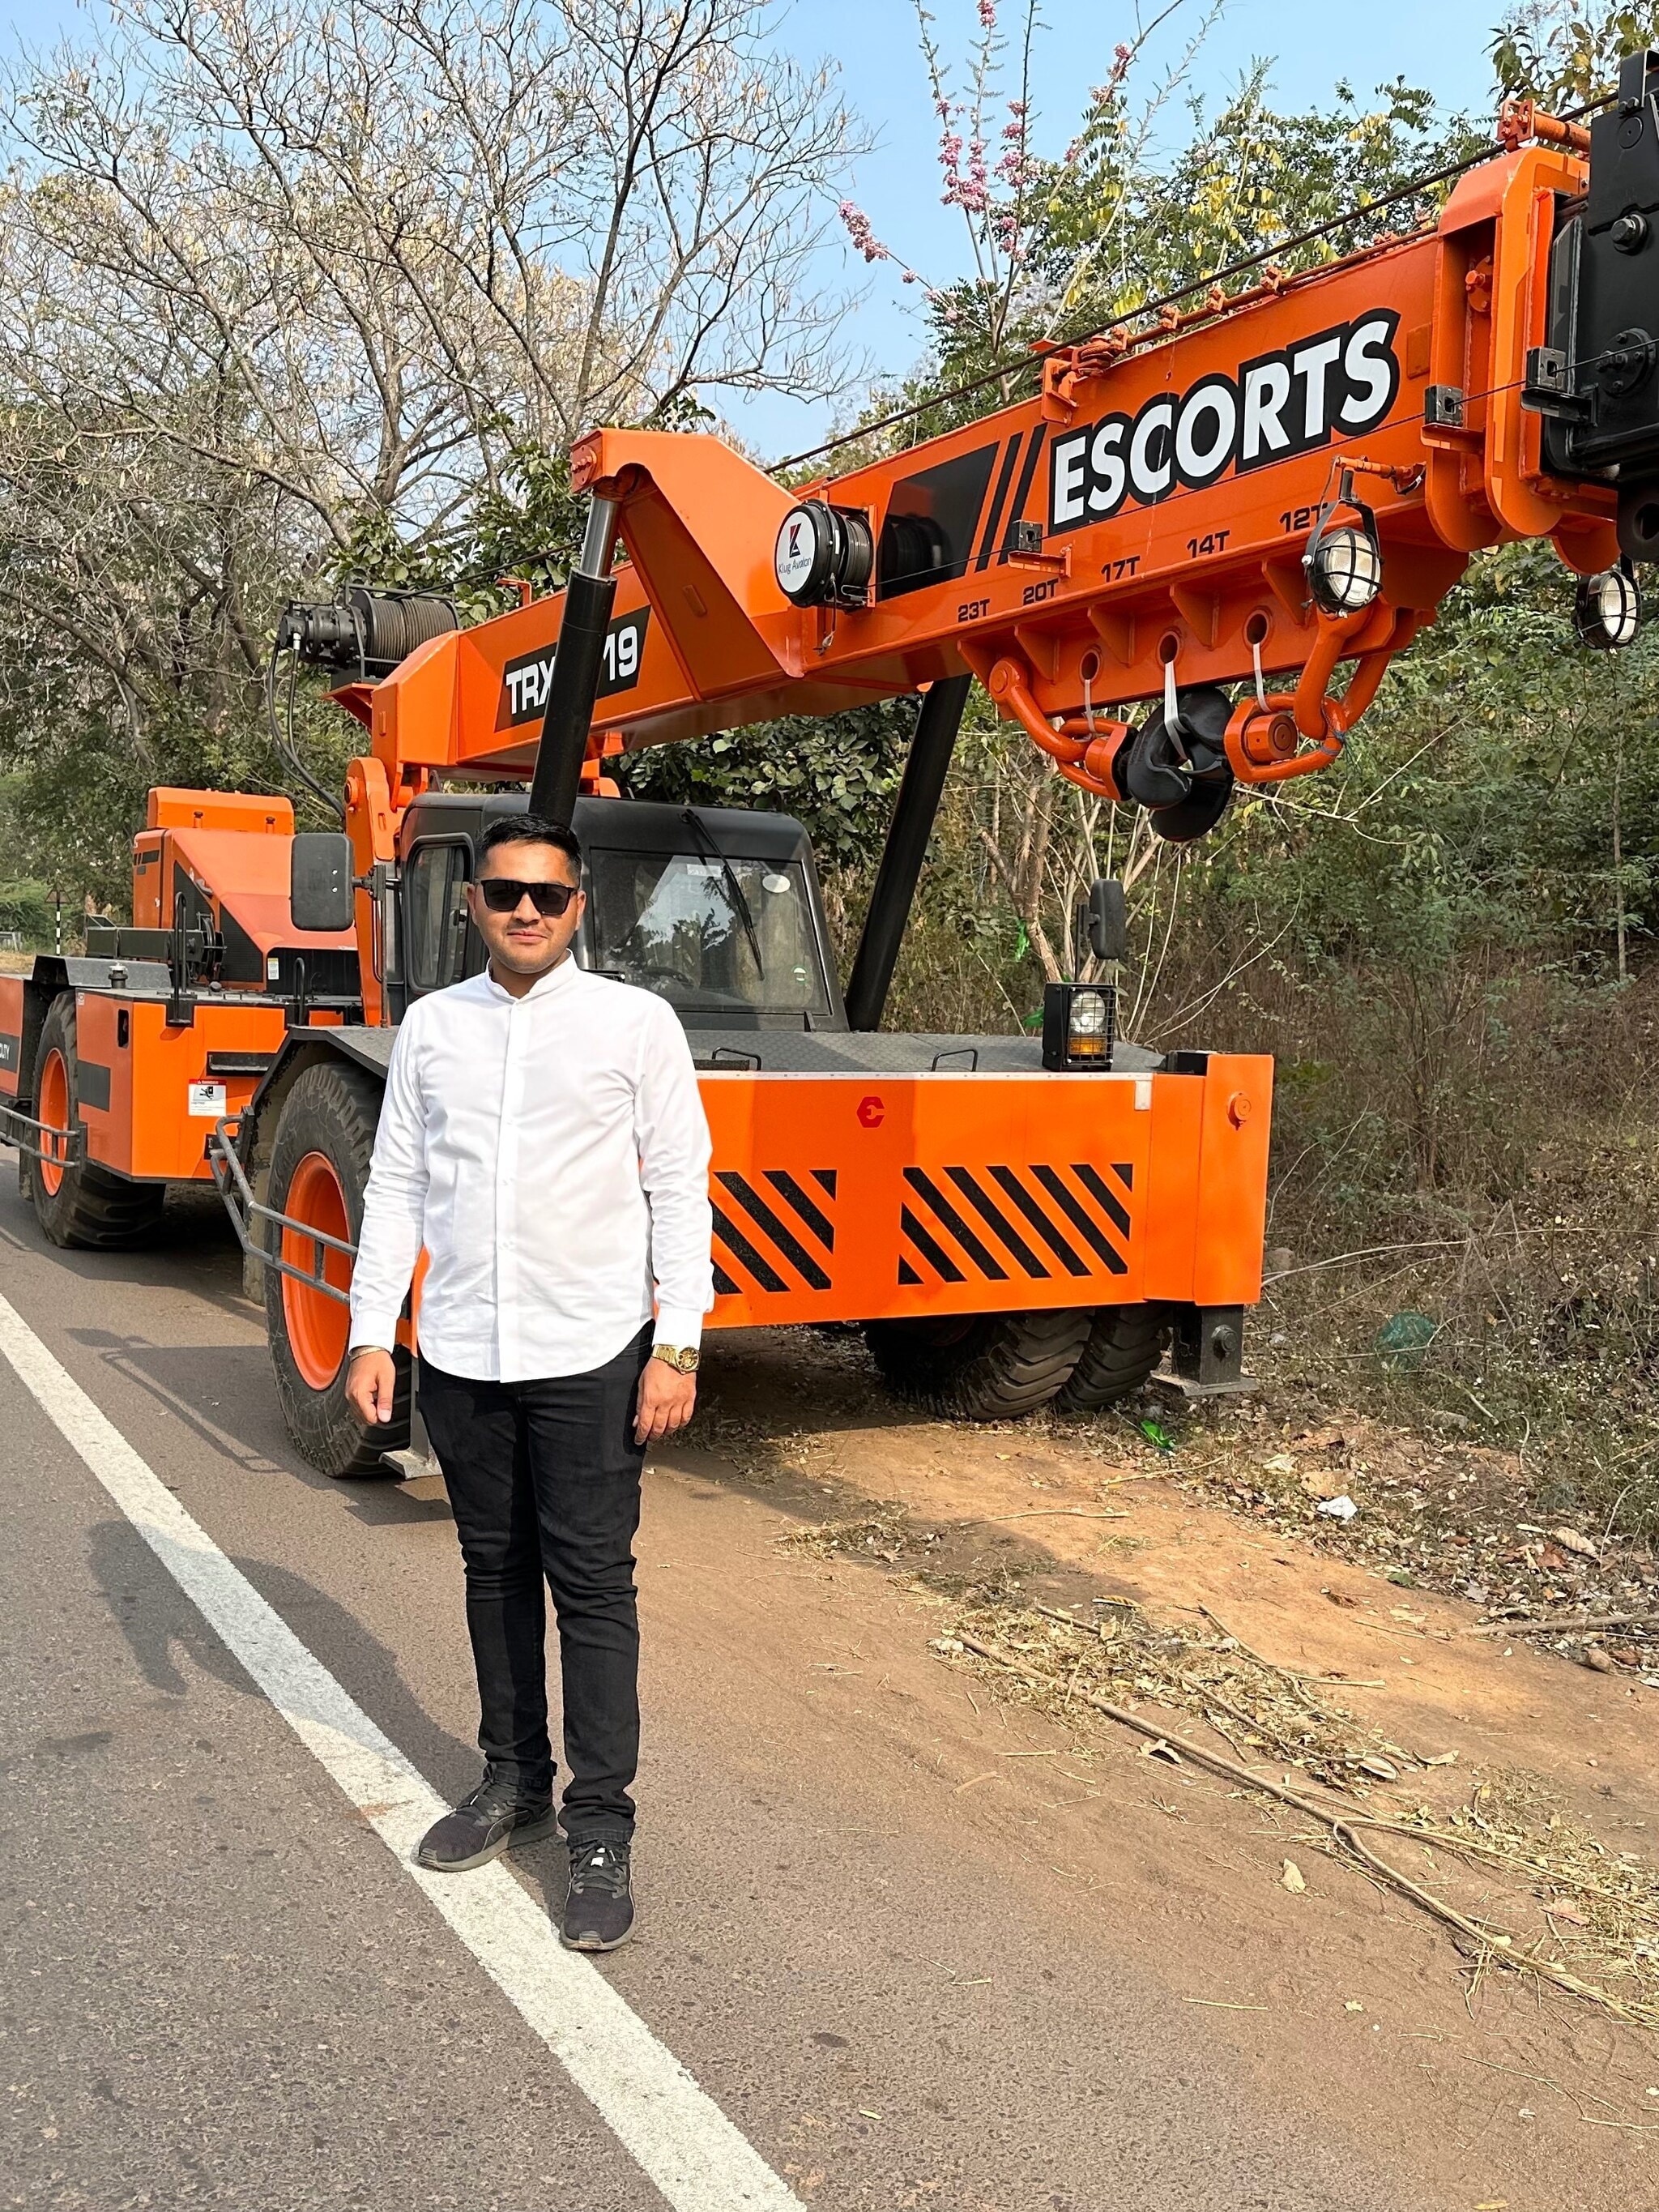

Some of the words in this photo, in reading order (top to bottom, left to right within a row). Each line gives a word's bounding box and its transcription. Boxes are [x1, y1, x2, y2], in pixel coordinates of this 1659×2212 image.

[1053, 320, 1391, 525] ESCORTS
[957, 598, 990, 622] 23T
[1023, 578, 1059, 606] 20T
[1101, 555, 1141, 583] 17T
[1187, 529, 1230, 558] 14T
[1279, 502, 1328, 532] 12T
